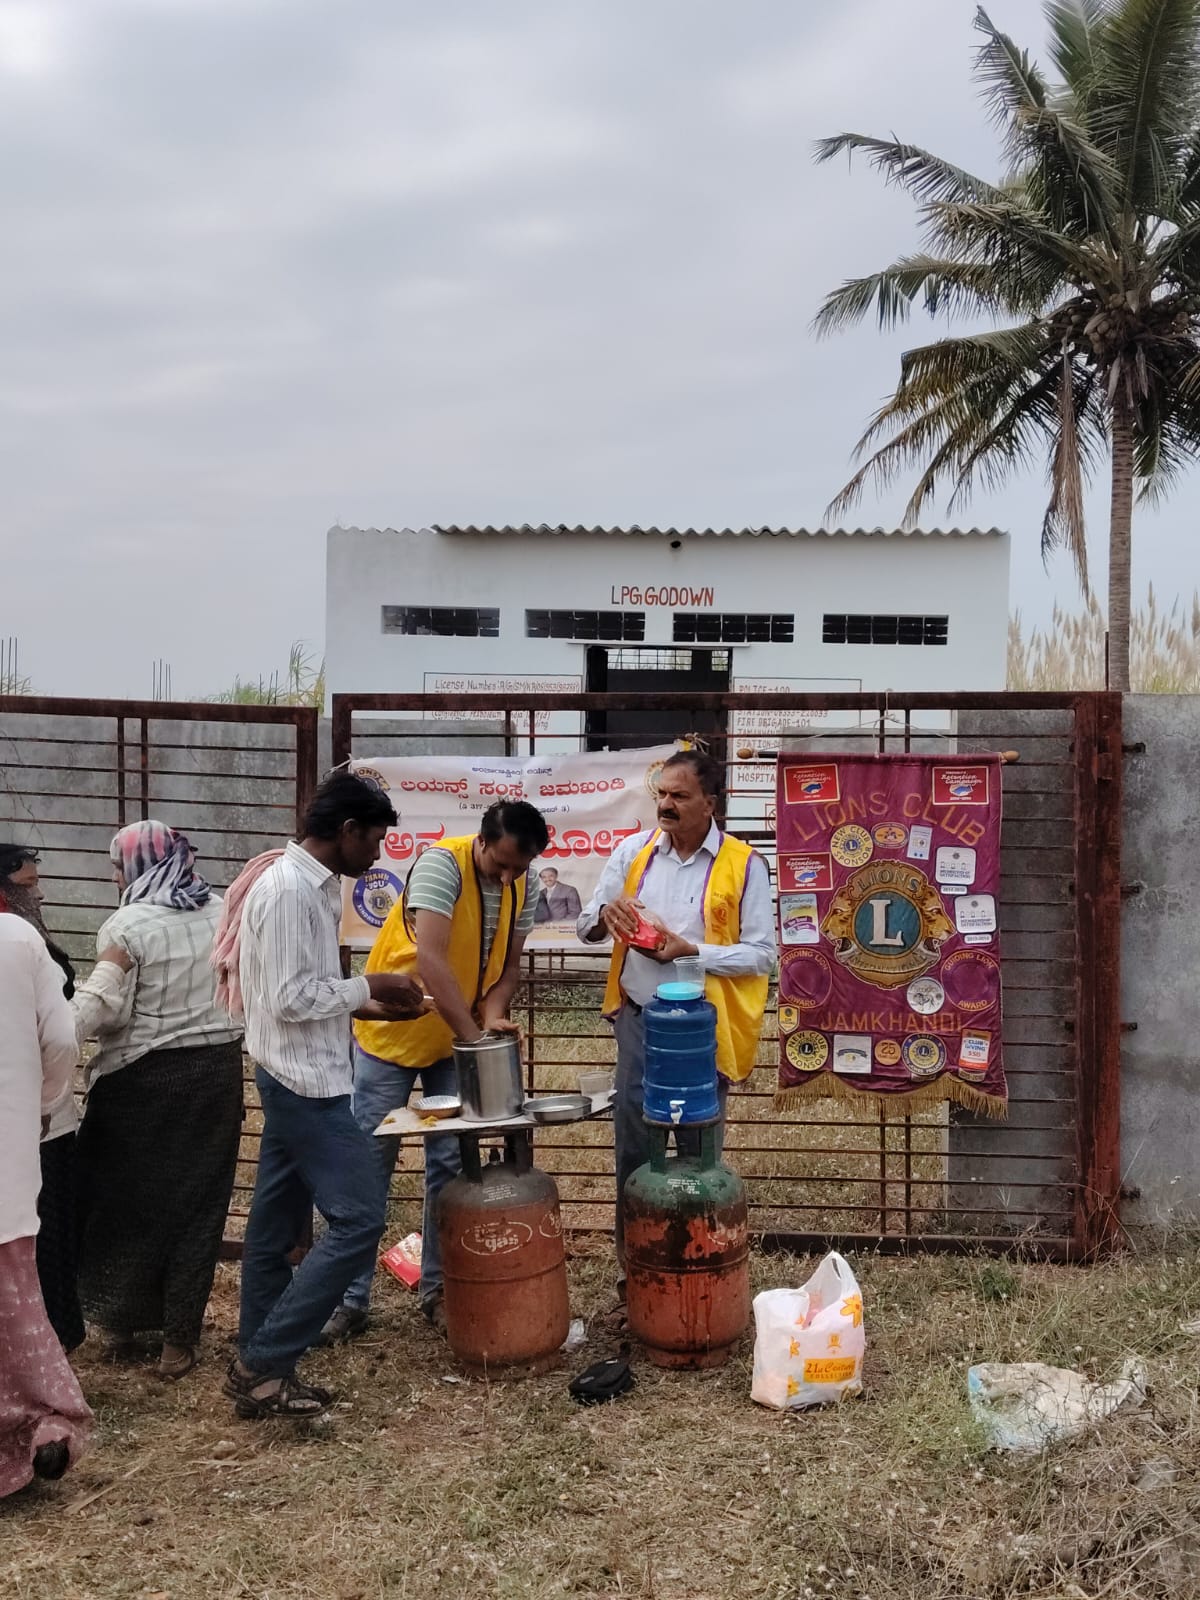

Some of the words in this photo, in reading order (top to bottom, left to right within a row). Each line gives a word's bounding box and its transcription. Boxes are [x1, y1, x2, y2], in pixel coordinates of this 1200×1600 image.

[611, 585, 642, 605] LPG
[645, 586, 714, 606] GODOWN
[738, 717, 755, 727] FIRE
[738, 773, 776, 783] HOSPITA
[401, 778, 469, 799] ಲಯನ್ಸ್
[539, 777, 625, 797] ಜಮಖಂಡಿ
[792, 791, 888, 841] LIONS
[903, 793, 986, 846] CLUB
[832, 828, 847, 848] NEW
[850, 826, 871, 842] CLUB
[834, 846, 872, 866] SPONSOR
[368, 880, 385, 889] YOU
[857, 869, 921, 893] LIONS
[869, 900, 904, 945] L
[783, 949, 813, 965] GUIDING
[815, 954, 828, 970] LION
[945, 952, 974, 971] GUIDING
[976, 953, 994, 969] LION
[788, 994, 816, 1007] AWARD
[958, 999, 987, 1009] AWARD
[820, 1011, 962, 1032] JAMKHANDI
[788, 1032, 805, 1048] NEW
[810, 1032, 826, 1050] CLUB
[881, 1043, 896, 1055] 25
[788, 1051, 826, 1069] SPONSOR
